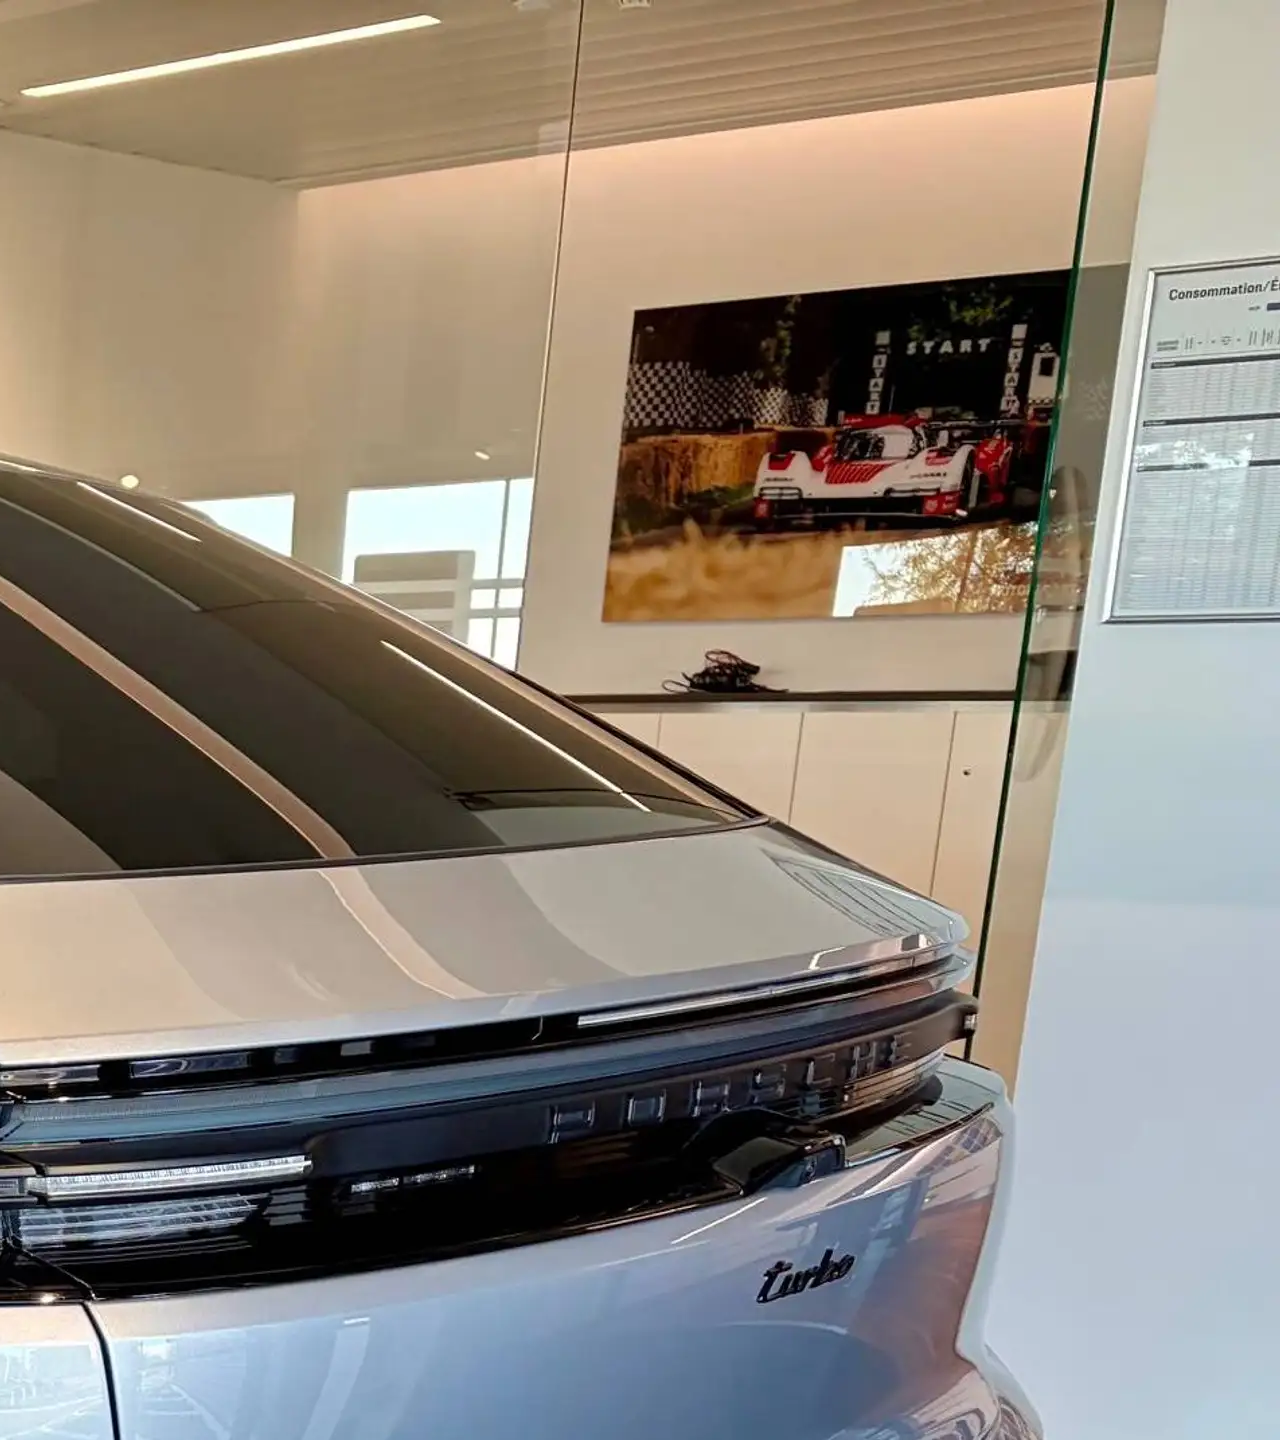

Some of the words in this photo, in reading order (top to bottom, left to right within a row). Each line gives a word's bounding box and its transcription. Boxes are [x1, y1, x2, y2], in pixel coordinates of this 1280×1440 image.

[906, 338, 991, 356] START
[547, 1030, 913, 1145] PORSCHE
[755, 1248, 855, 1304] turbo
